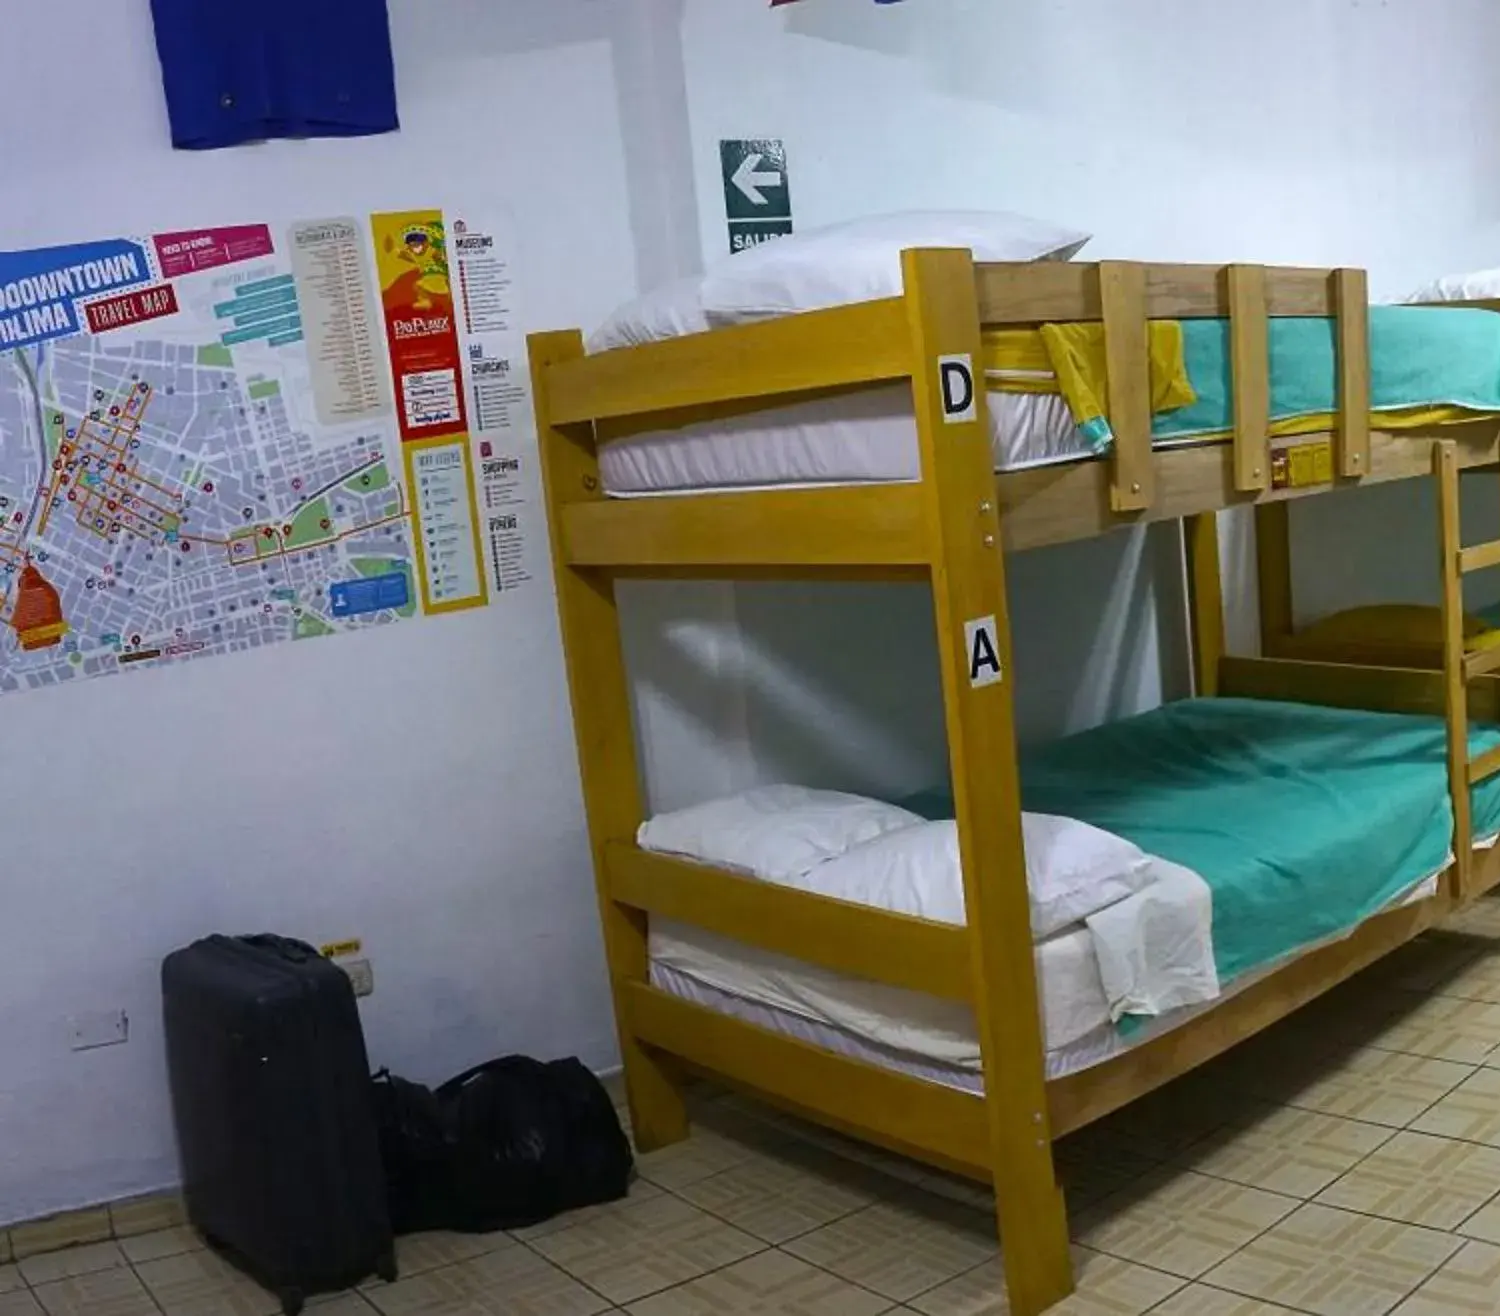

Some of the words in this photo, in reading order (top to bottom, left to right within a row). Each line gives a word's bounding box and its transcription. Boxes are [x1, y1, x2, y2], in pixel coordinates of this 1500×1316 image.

[91, 300, 138, 327] TRAVEL
[141, 288, 169, 313] MAP
[940, 362, 973, 414] D
[970, 628, 1000, 679] A
